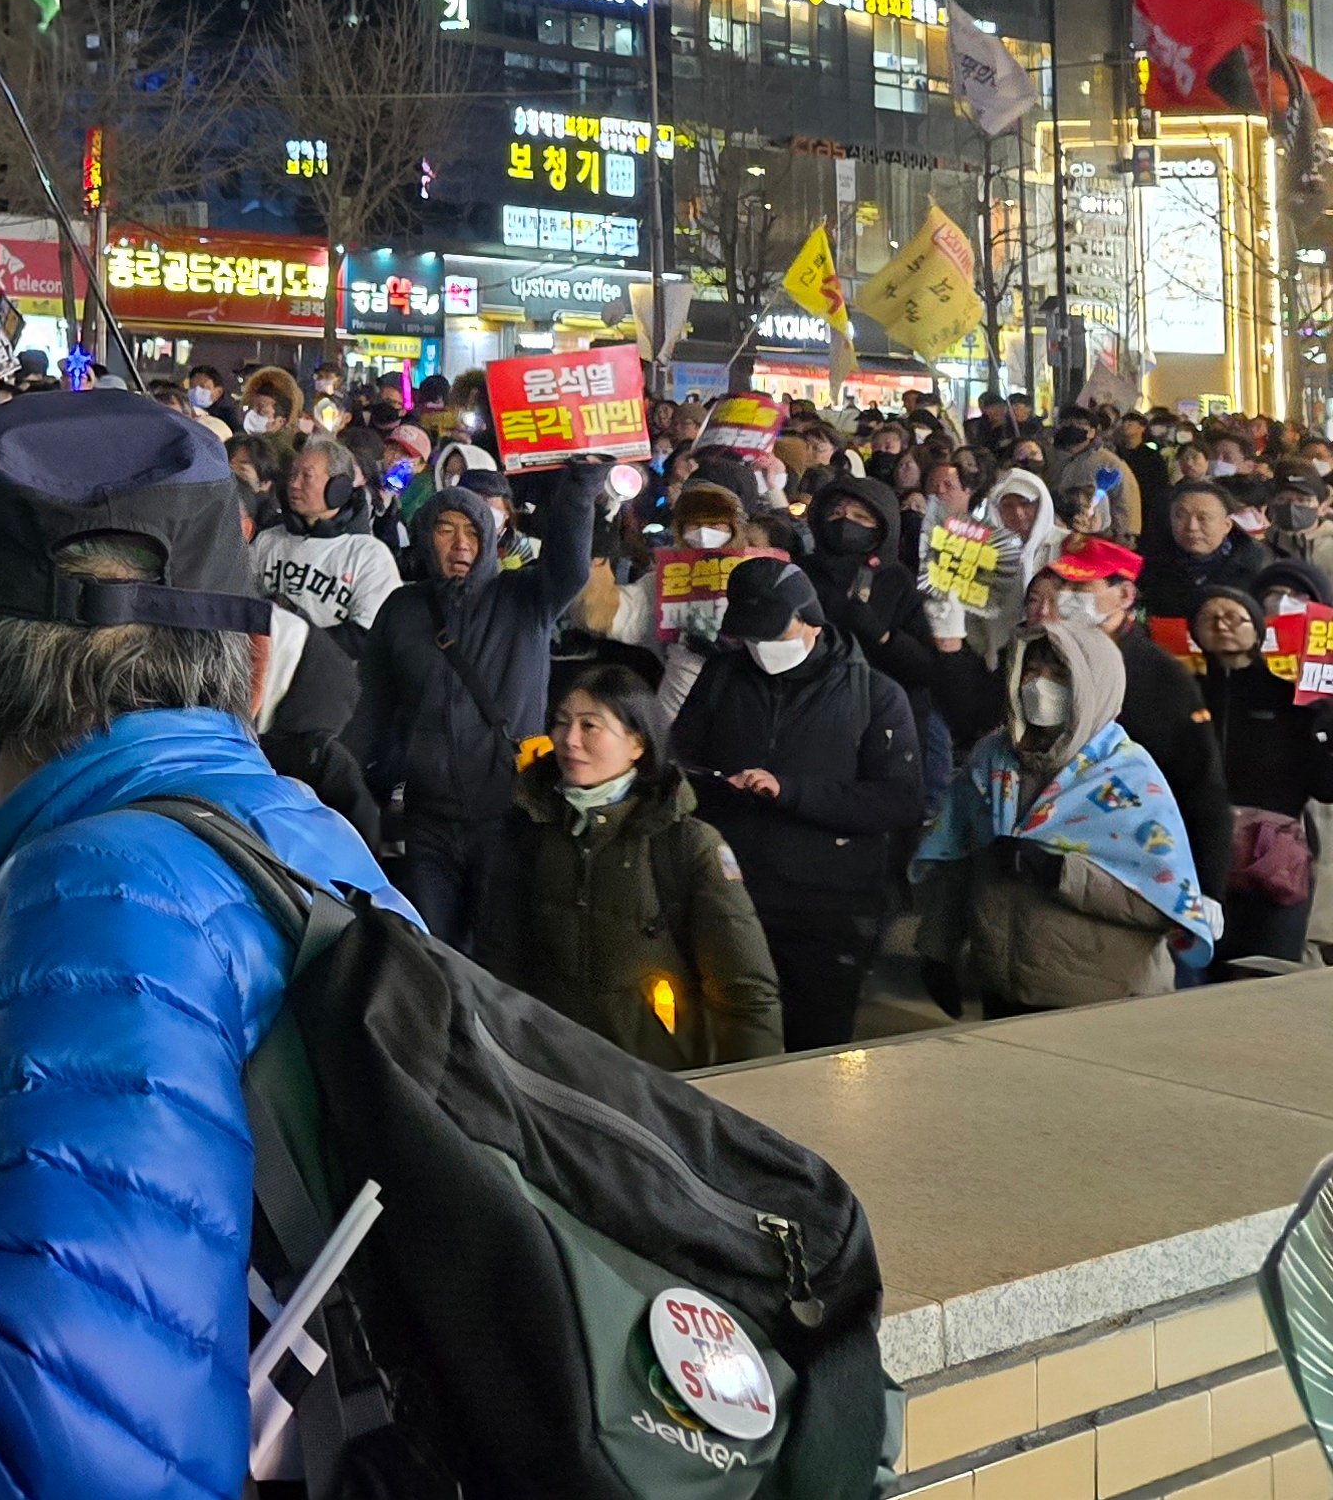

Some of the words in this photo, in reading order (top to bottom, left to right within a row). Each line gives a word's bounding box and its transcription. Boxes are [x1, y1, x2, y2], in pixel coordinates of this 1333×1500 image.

[507, 141, 600, 196] 보청기
[107, 247, 162, 289] 종로
[162, 251, 283, 297] 골든쥬얼리
[510, 276, 569, 304] upstore
[572, 278, 622, 304] coffee
[522, 362, 616, 402] 윤석열
[500, 408, 574, 444] 즉각
[582, 398, 643, 434] 파면!
[666, 1298, 737, 1346] STOP
[631, 1409, 748, 1475] deuter
